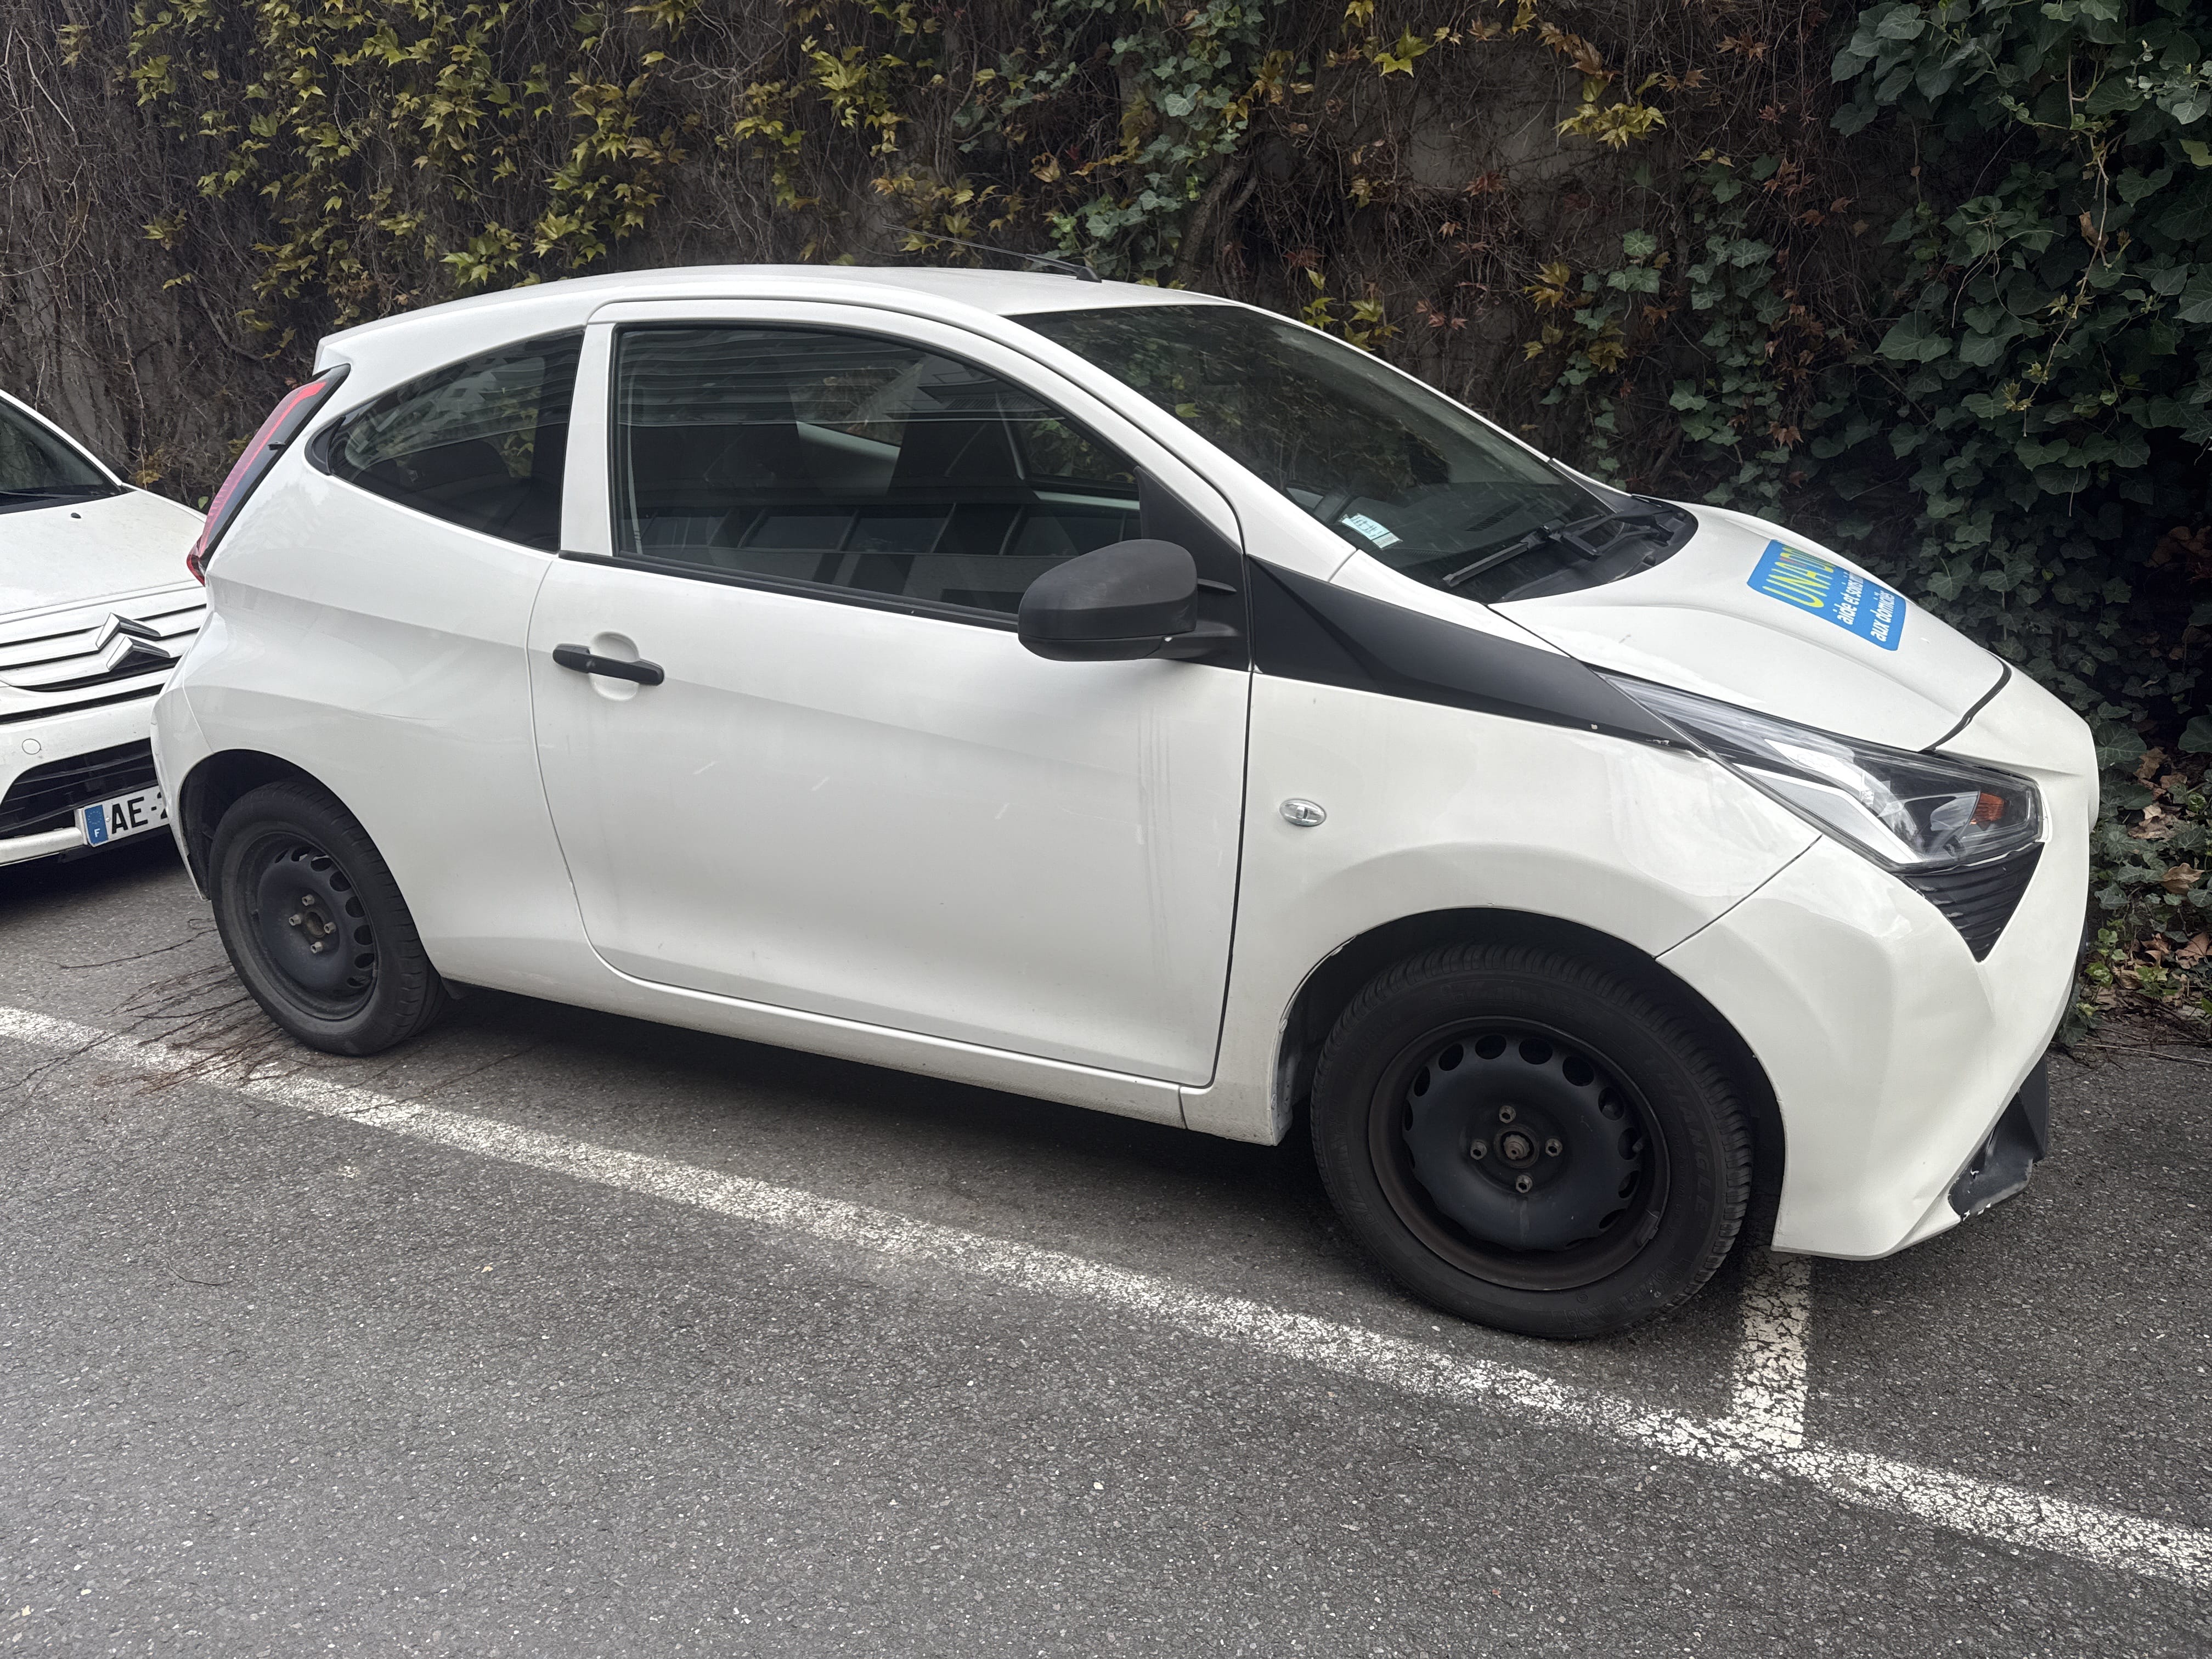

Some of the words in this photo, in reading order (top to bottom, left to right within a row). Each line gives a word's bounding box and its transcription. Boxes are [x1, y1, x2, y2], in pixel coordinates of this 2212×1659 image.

[1840, 591, 1860, 605] et
[1832, 602, 1858, 625] aide
[1870, 619, 1890, 642] aux
[94, 828, 100, 838] F
[1644, 1053, 1712, 1212] TRIANGLE
